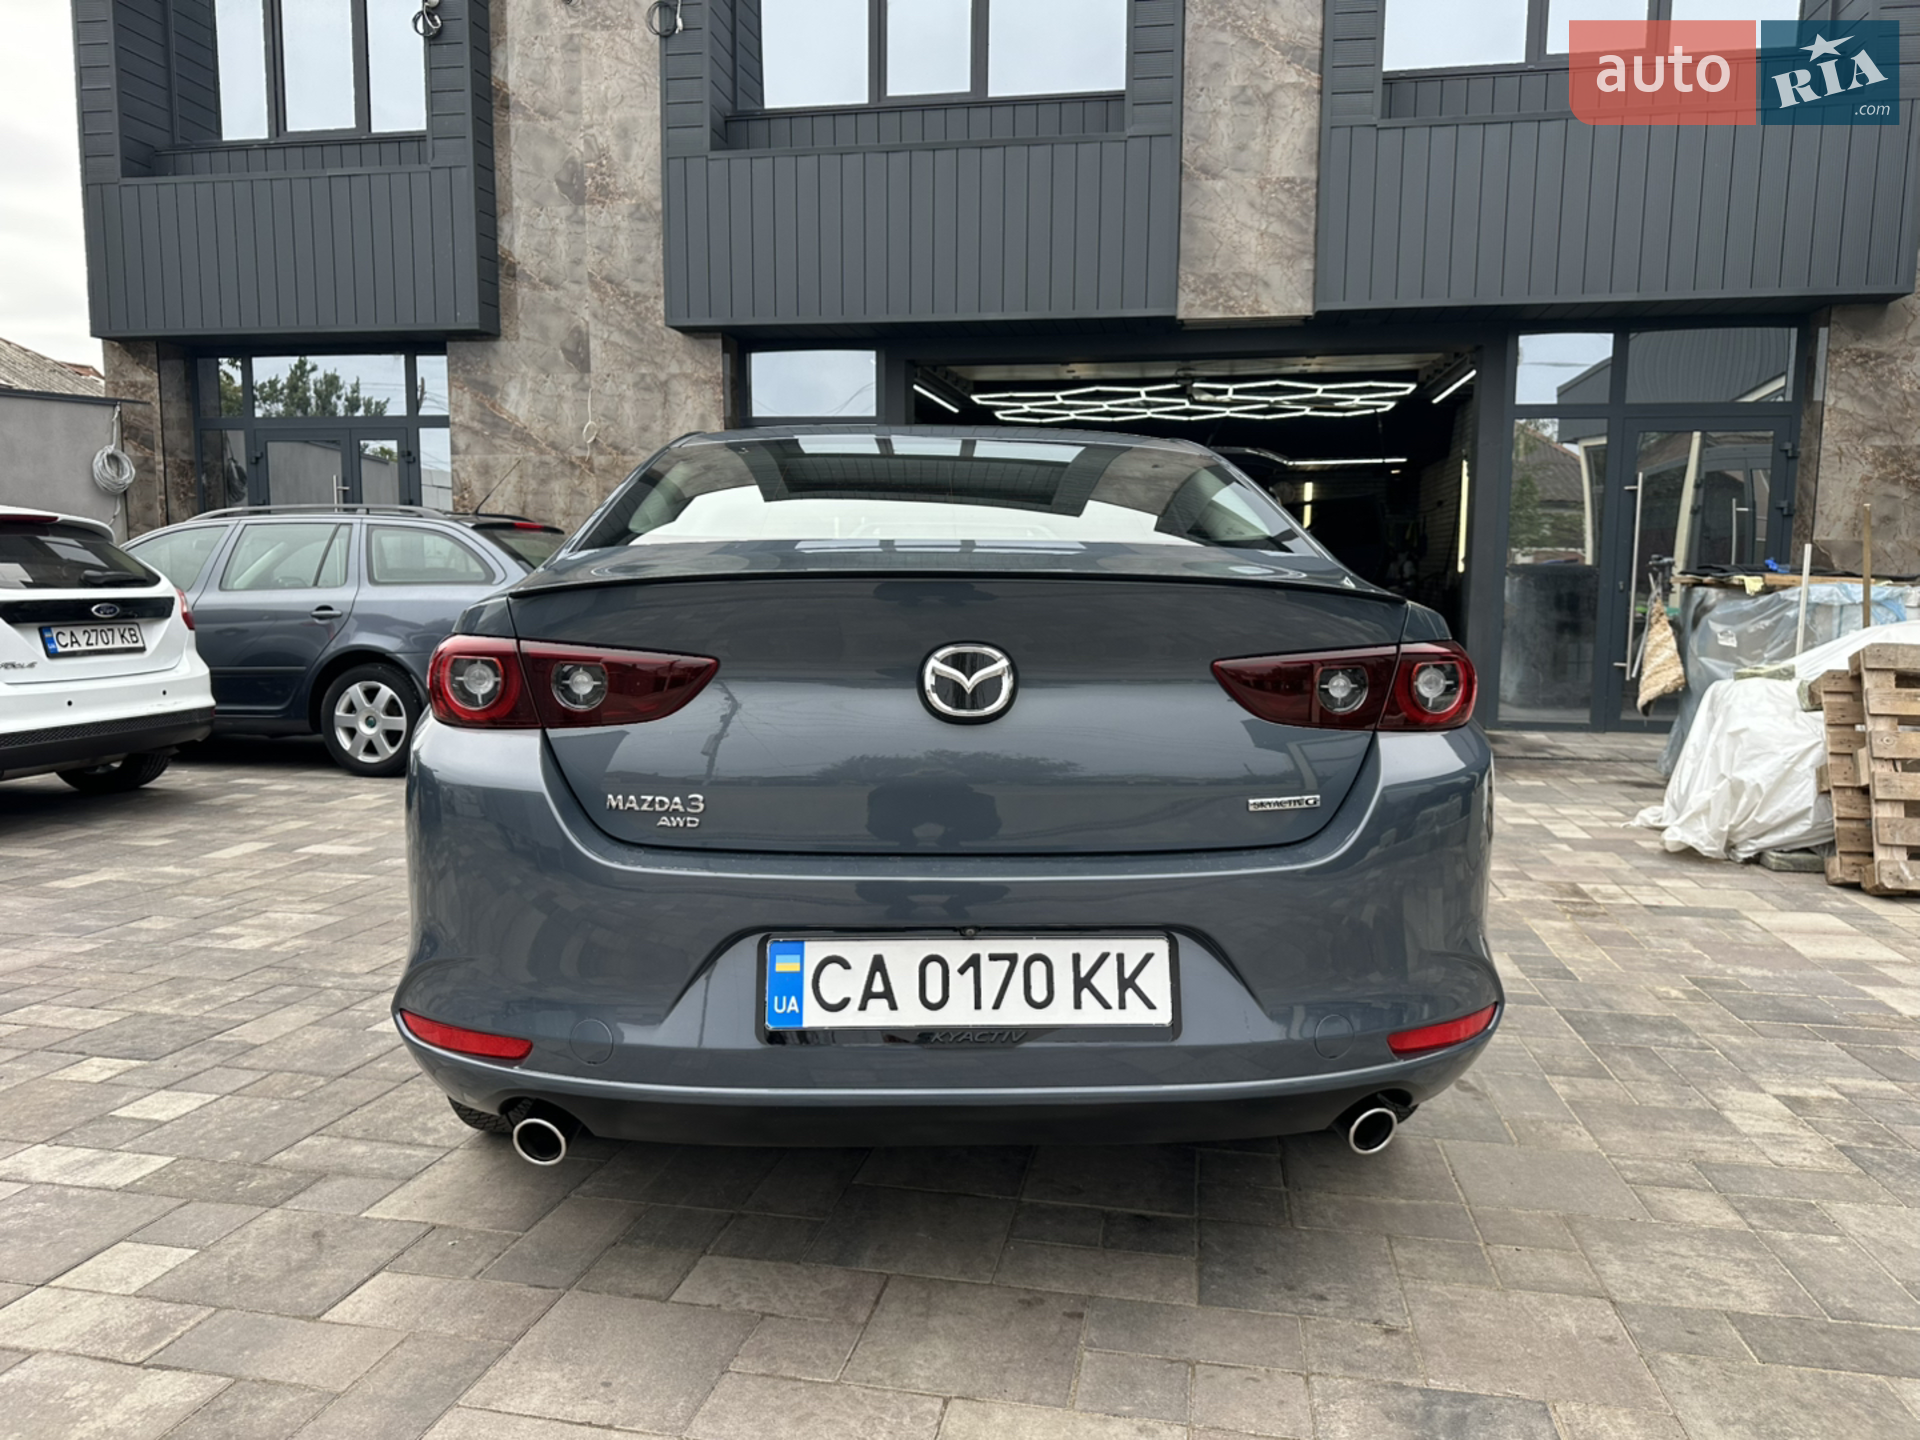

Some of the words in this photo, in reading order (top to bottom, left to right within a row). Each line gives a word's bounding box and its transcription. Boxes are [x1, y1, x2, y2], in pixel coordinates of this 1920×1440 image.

[56, 630, 81, 648] CA
[83, 628, 115, 646] 2707
[118, 627, 139, 644] KB
[656, 816, 700, 828] AWD
[811, 953, 898, 1013] CA
[918, 952, 1054, 1010] 0170
[1072, 951, 1157, 1010] KK
[774, 995, 800, 1013] UA
